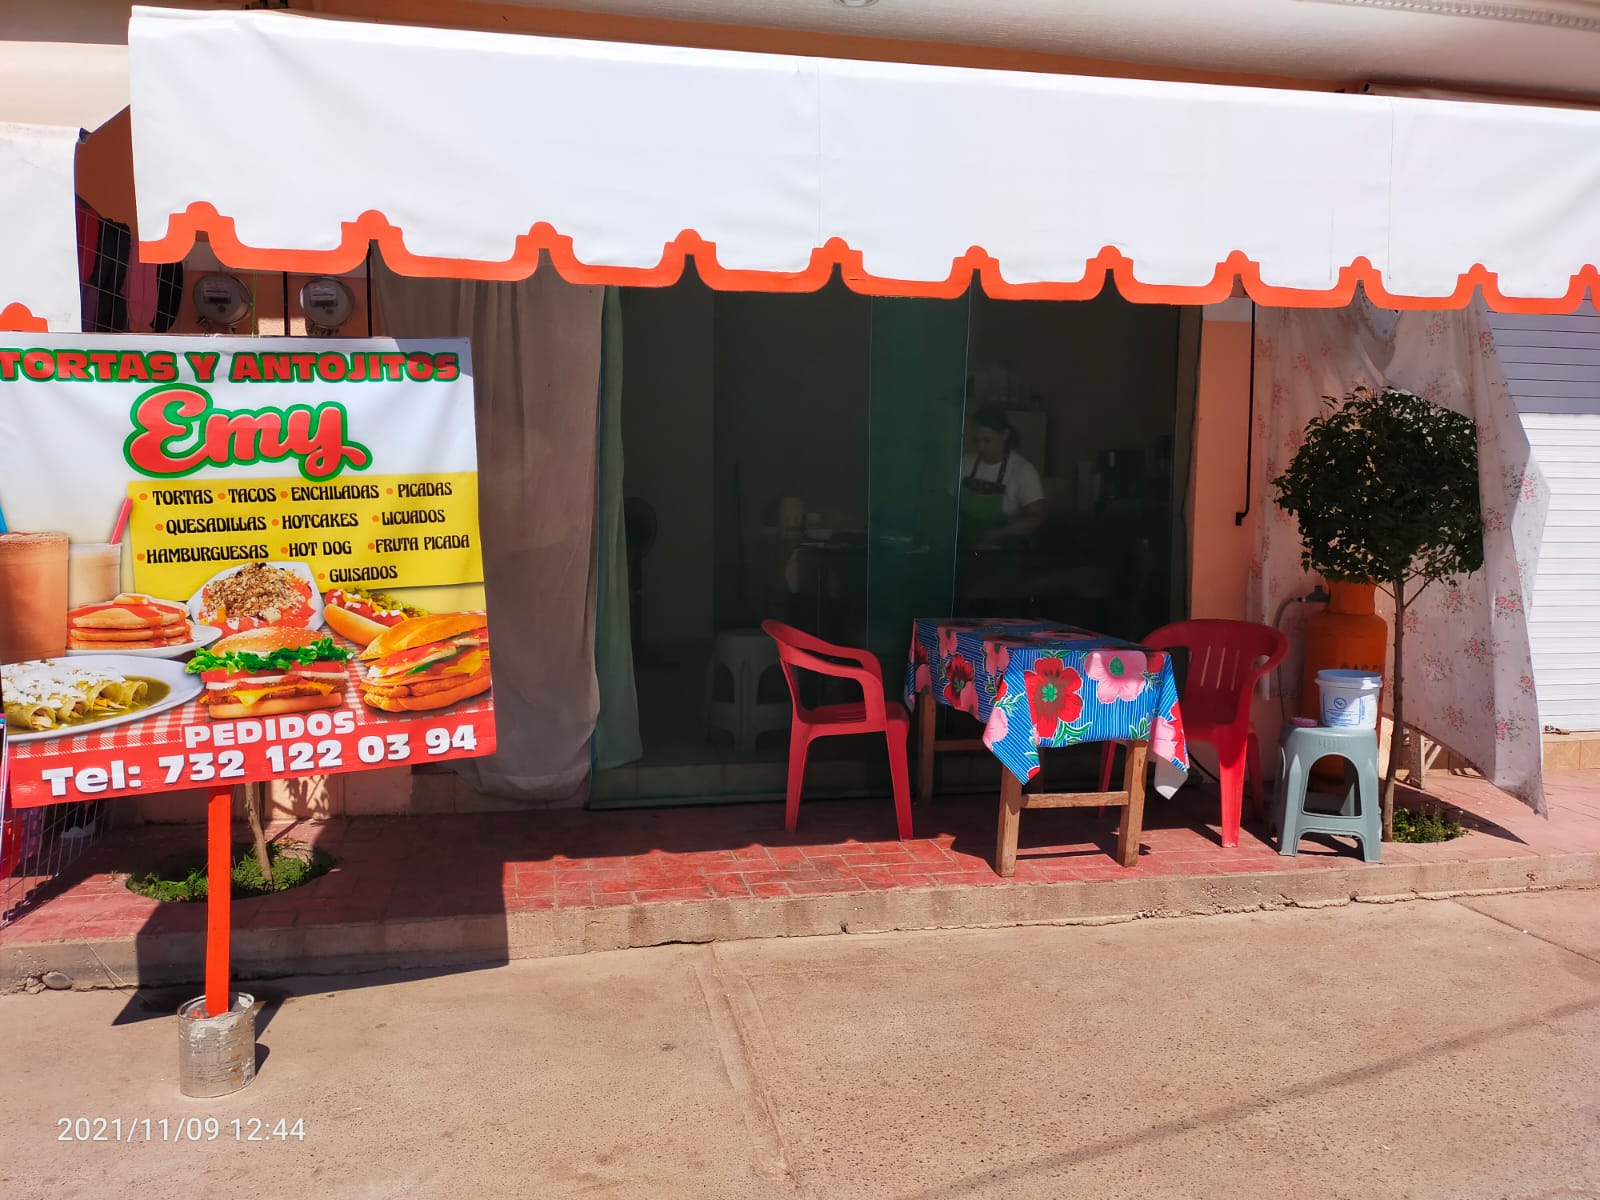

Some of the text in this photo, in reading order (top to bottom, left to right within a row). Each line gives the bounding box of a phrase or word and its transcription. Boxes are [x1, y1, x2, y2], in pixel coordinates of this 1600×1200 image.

[0, 348, 459, 383] TORTAS Y ANTOJITOS
[123, 383, 373, 482] Emy
[153, 482, 452, 505] TORTAS TACOS ENCHILADAS PICADAS
[166, 509, 445, 534] QUESADILLAS HOTCAKES LICUADOS
[146, 534, 470, 564] HAMBURGUESAS HOT DOG FRUTA PICADA
[329, 566, 398, 583] GUISADOS
[185, 711, 356, 748] PEDIDOS
[41, 724, 478, 797] Tel: 732 122 03 94
